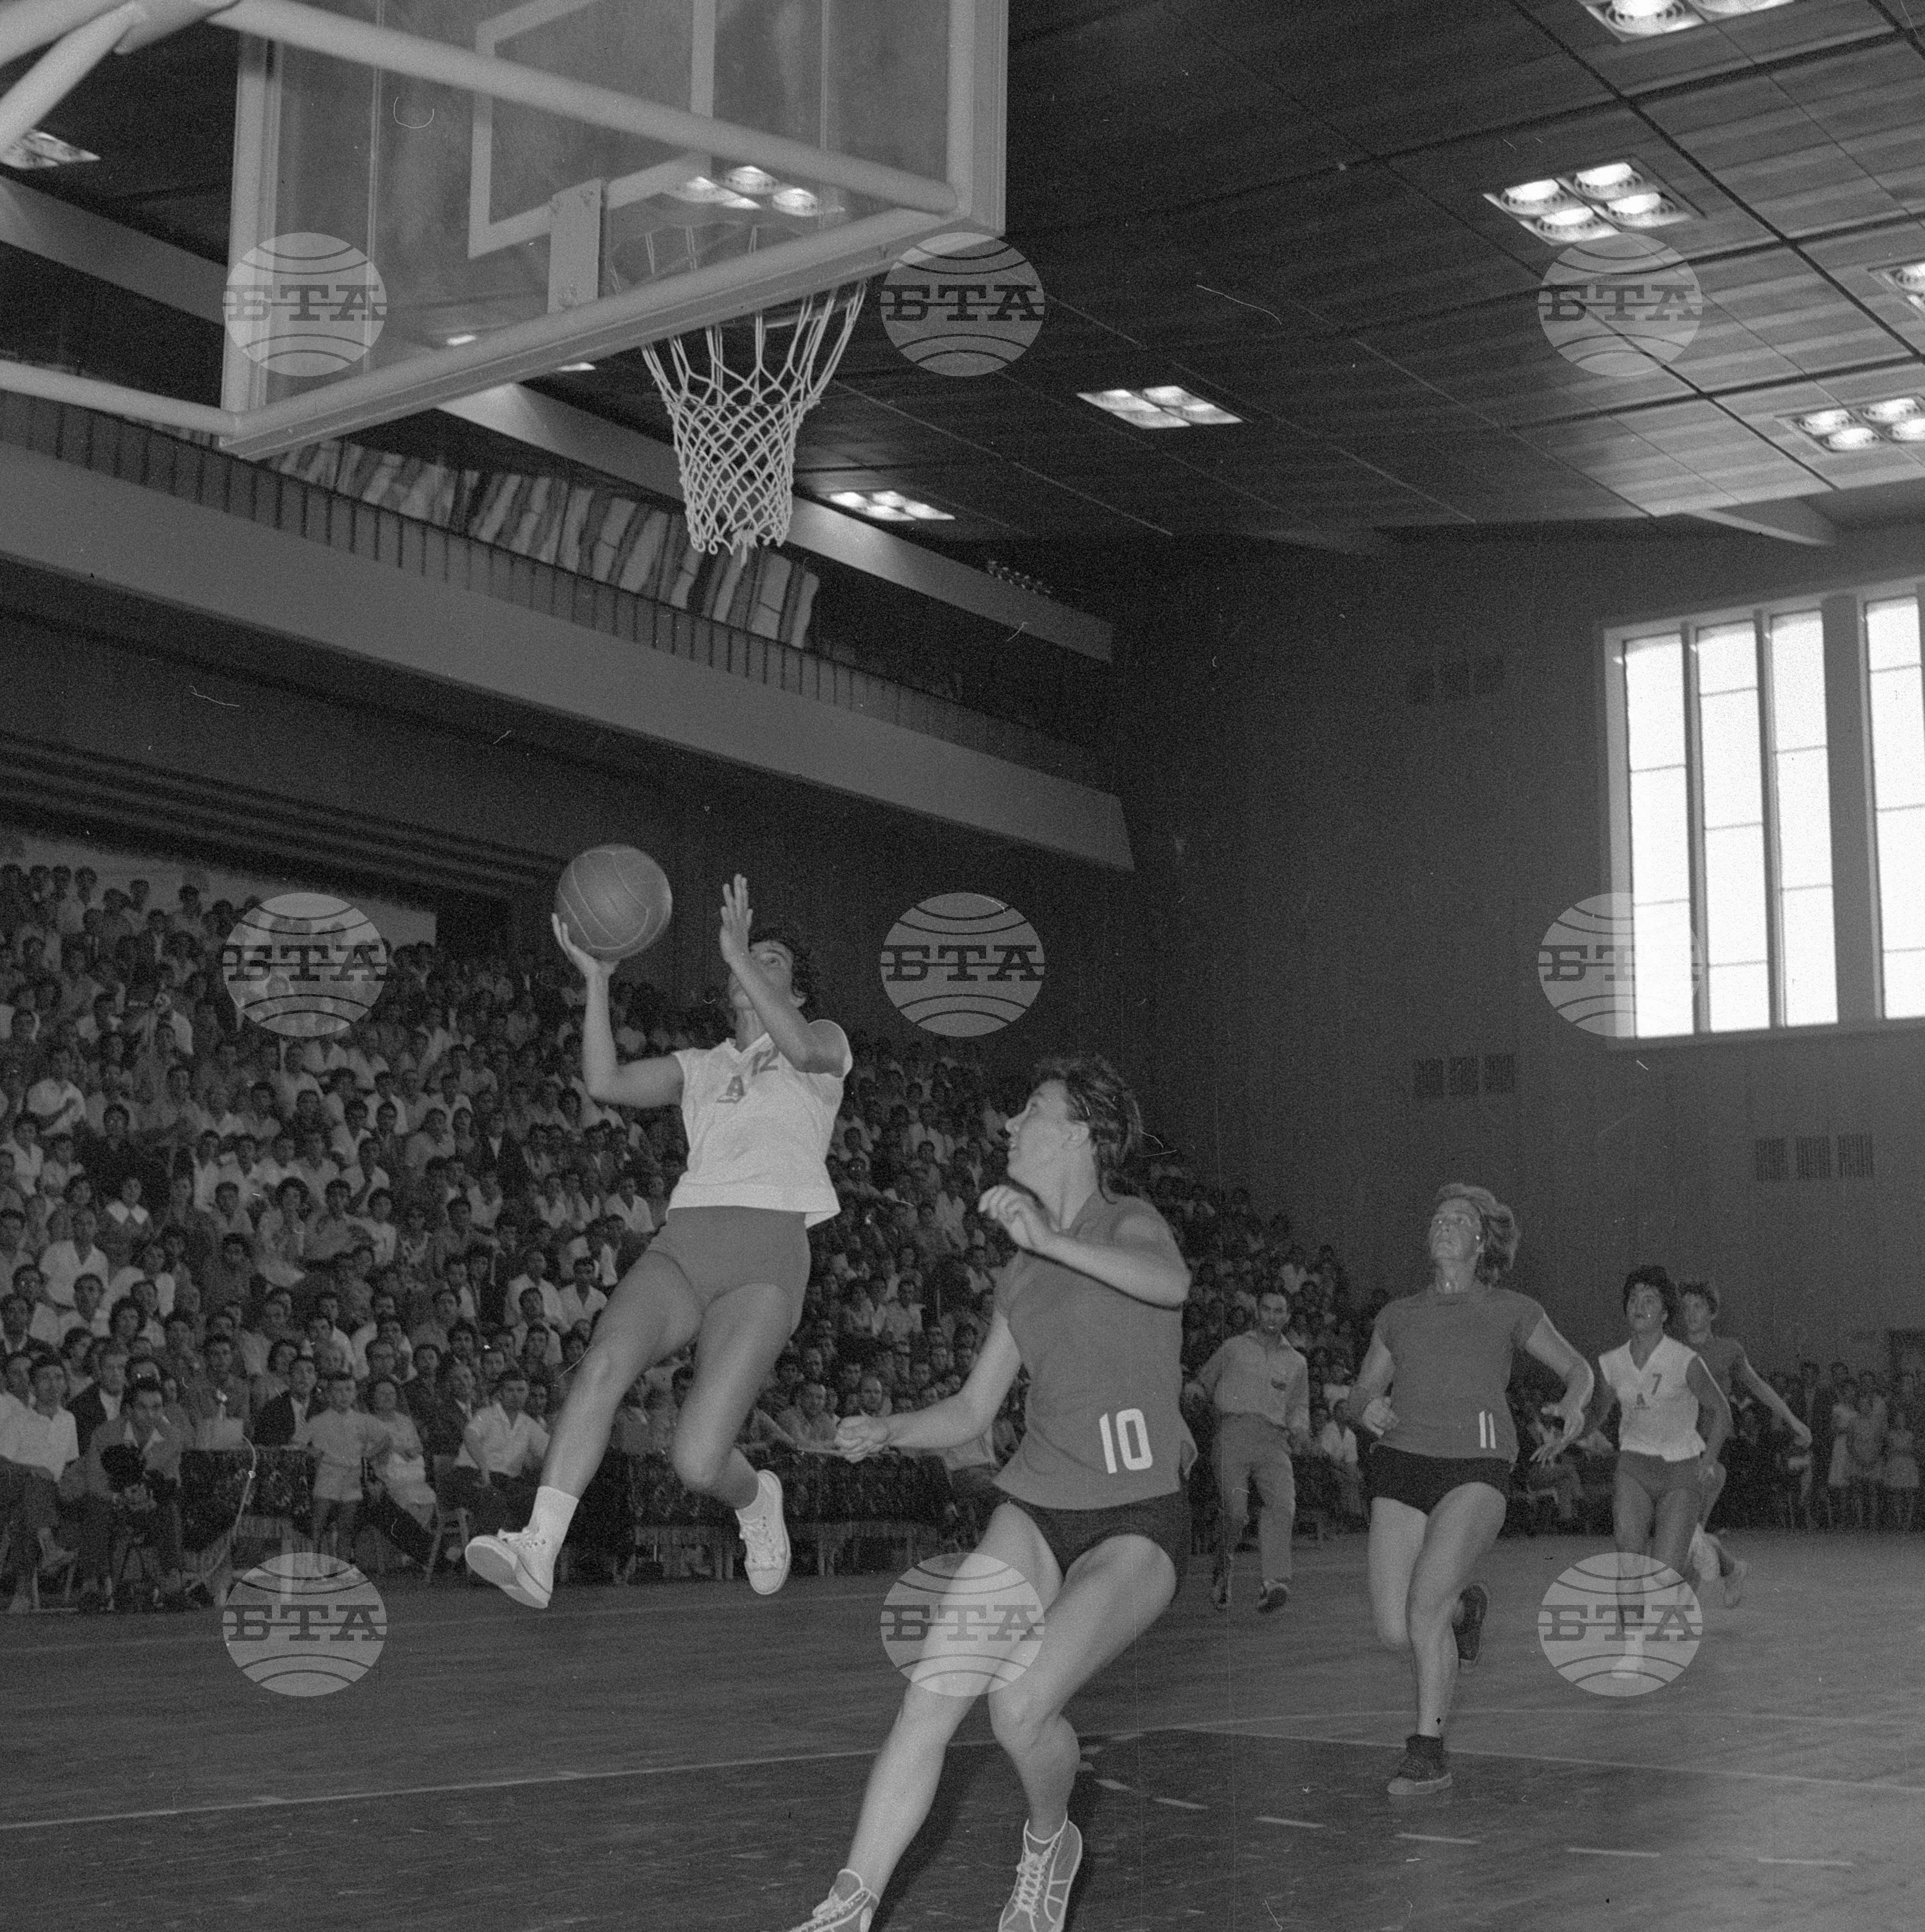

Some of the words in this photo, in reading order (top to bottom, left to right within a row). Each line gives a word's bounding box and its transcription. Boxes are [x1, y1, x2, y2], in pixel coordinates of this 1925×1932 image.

[1652, 1373, 1662, 1395] 7
[1099, 1407, 1154, 1474] 10
[1479, 1409, 1497, 1449] 11
